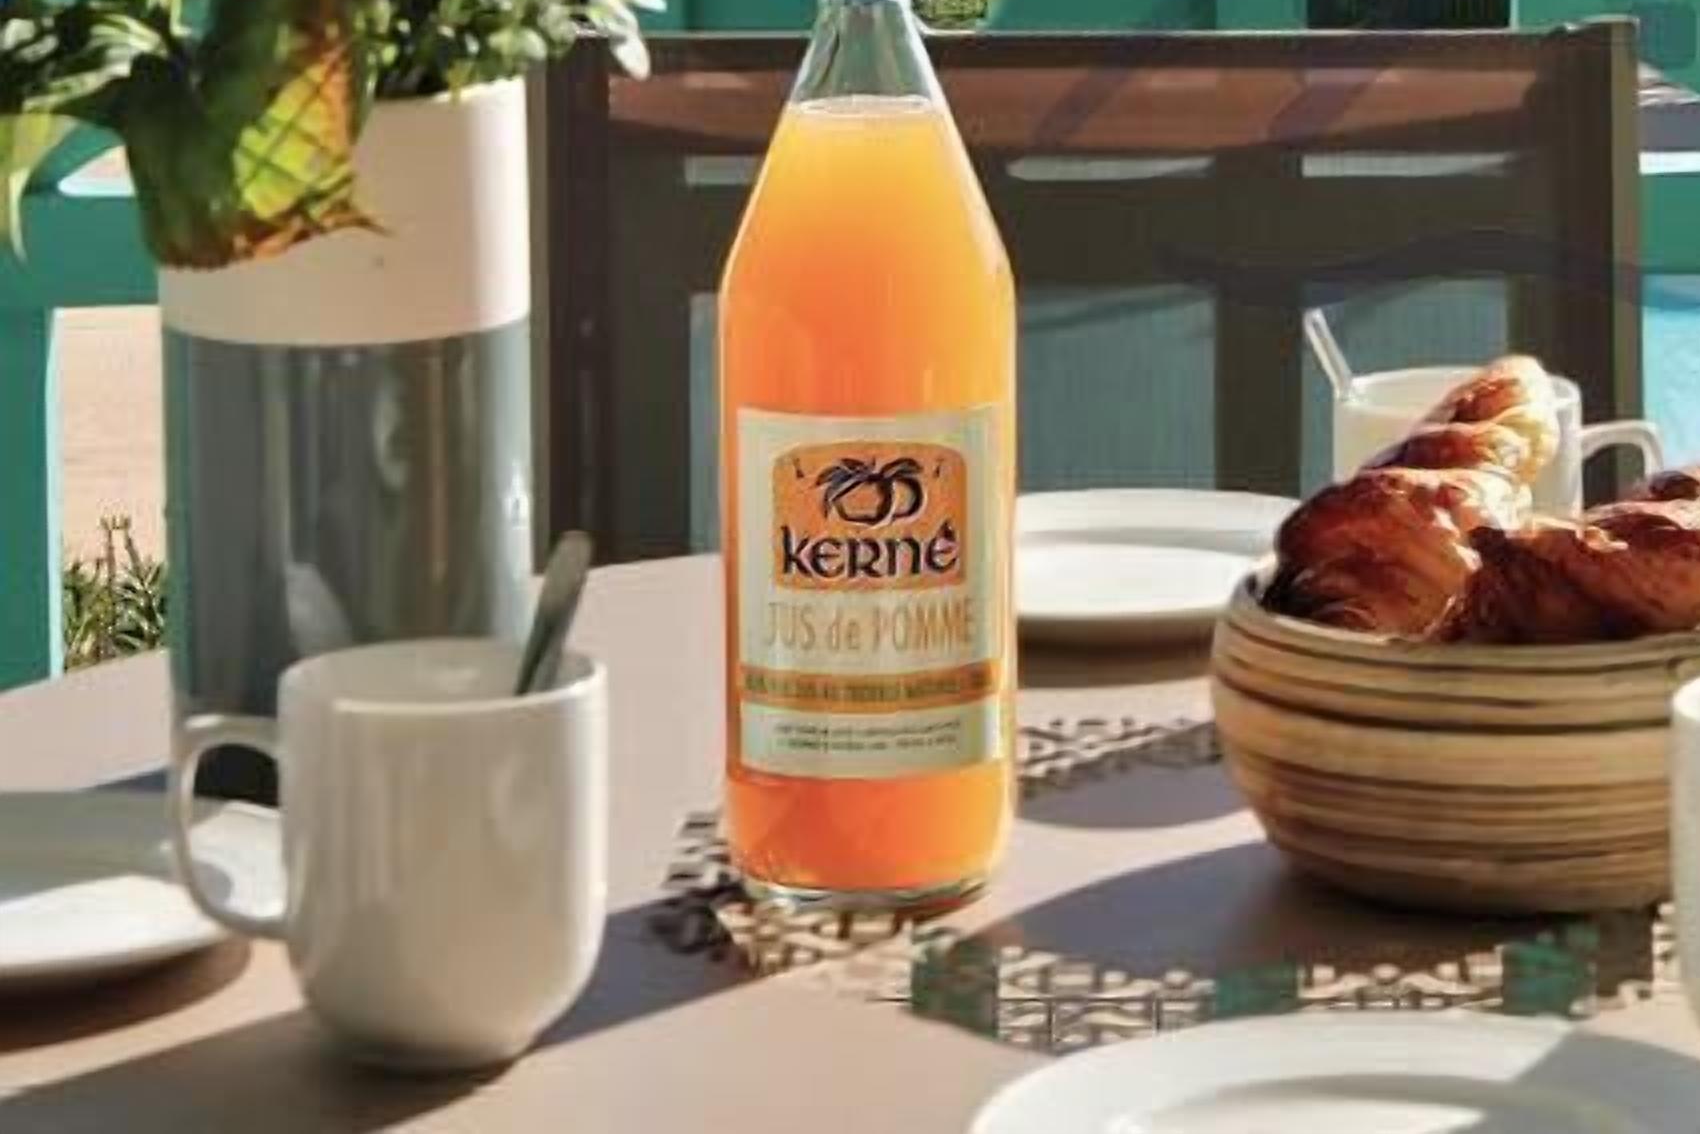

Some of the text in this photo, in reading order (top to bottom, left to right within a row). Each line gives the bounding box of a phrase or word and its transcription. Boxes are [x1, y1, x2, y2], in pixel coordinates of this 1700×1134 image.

[763, 597, 975, 652] JUS de POMME
